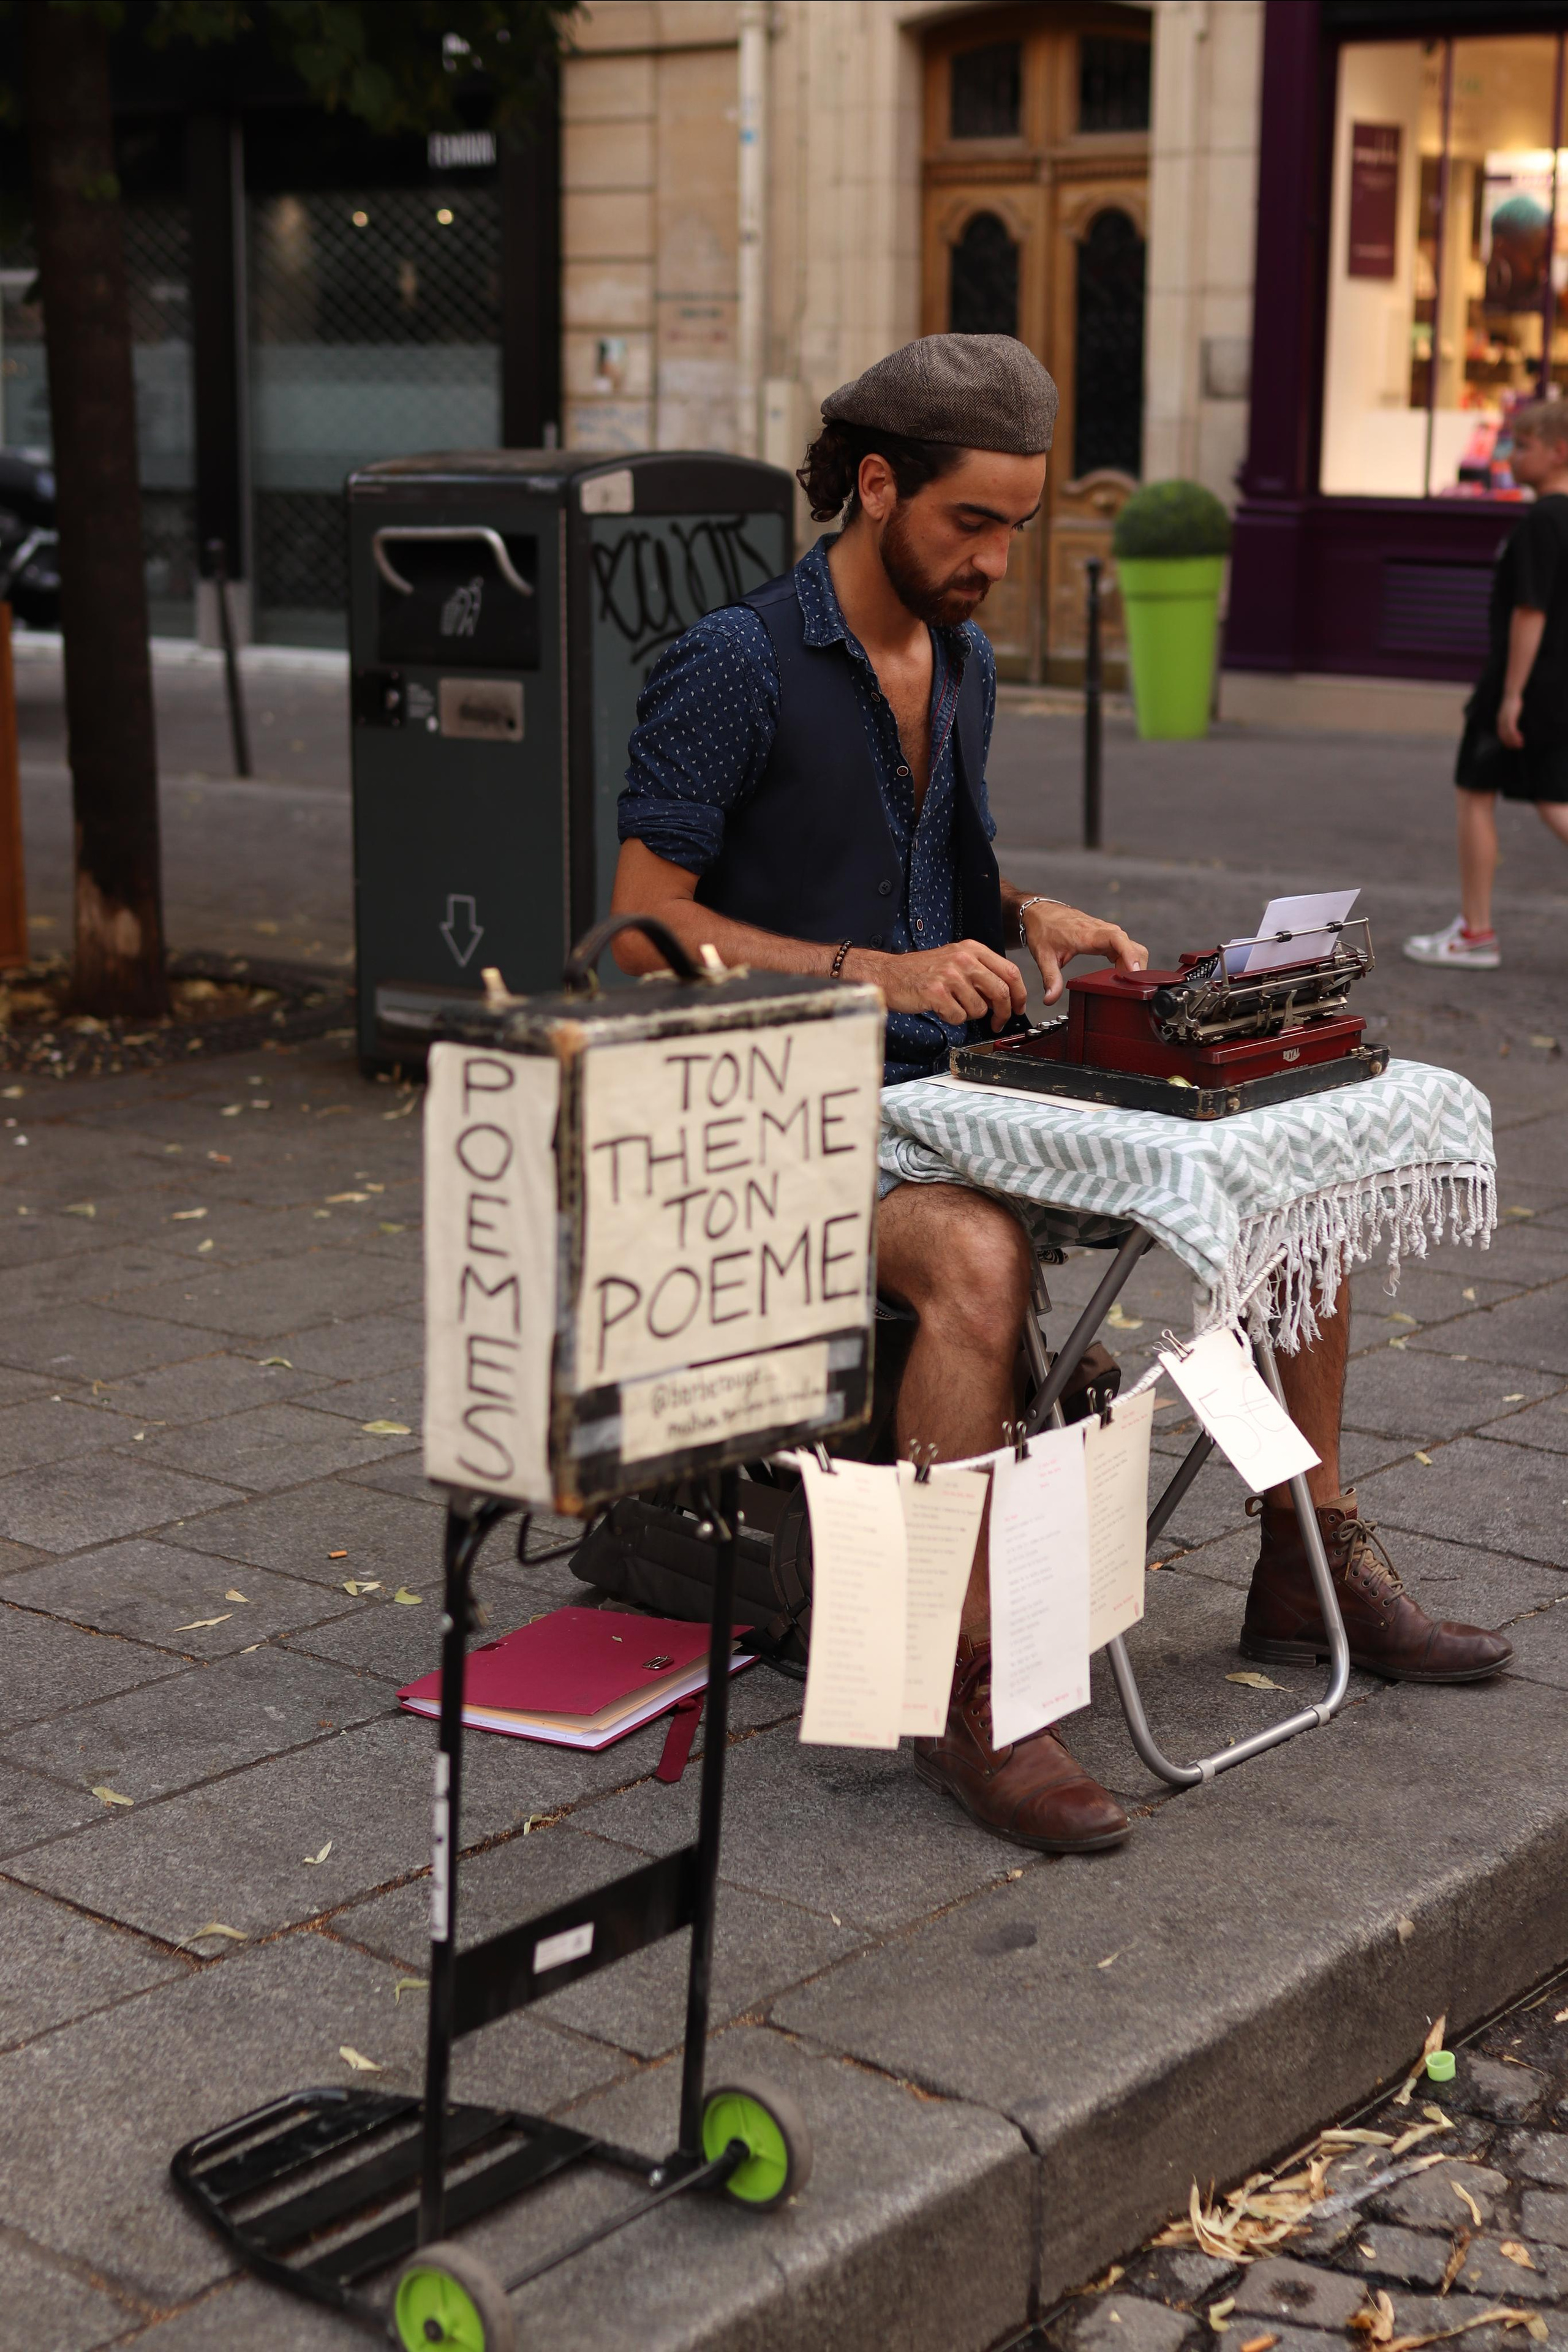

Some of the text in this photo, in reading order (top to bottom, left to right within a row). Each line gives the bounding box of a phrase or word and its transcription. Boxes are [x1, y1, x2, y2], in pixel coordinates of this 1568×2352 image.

[665, 1036, 793, 1112] TON
[592, 1087, 861, 1204] THEME
[663, 1172, 778, 1250] TON
[456, 1057, 522, 1482] POEMES
[593, 1213, 861, 1373] POEME
[1198, 1376, 1289, 1460] 5€
